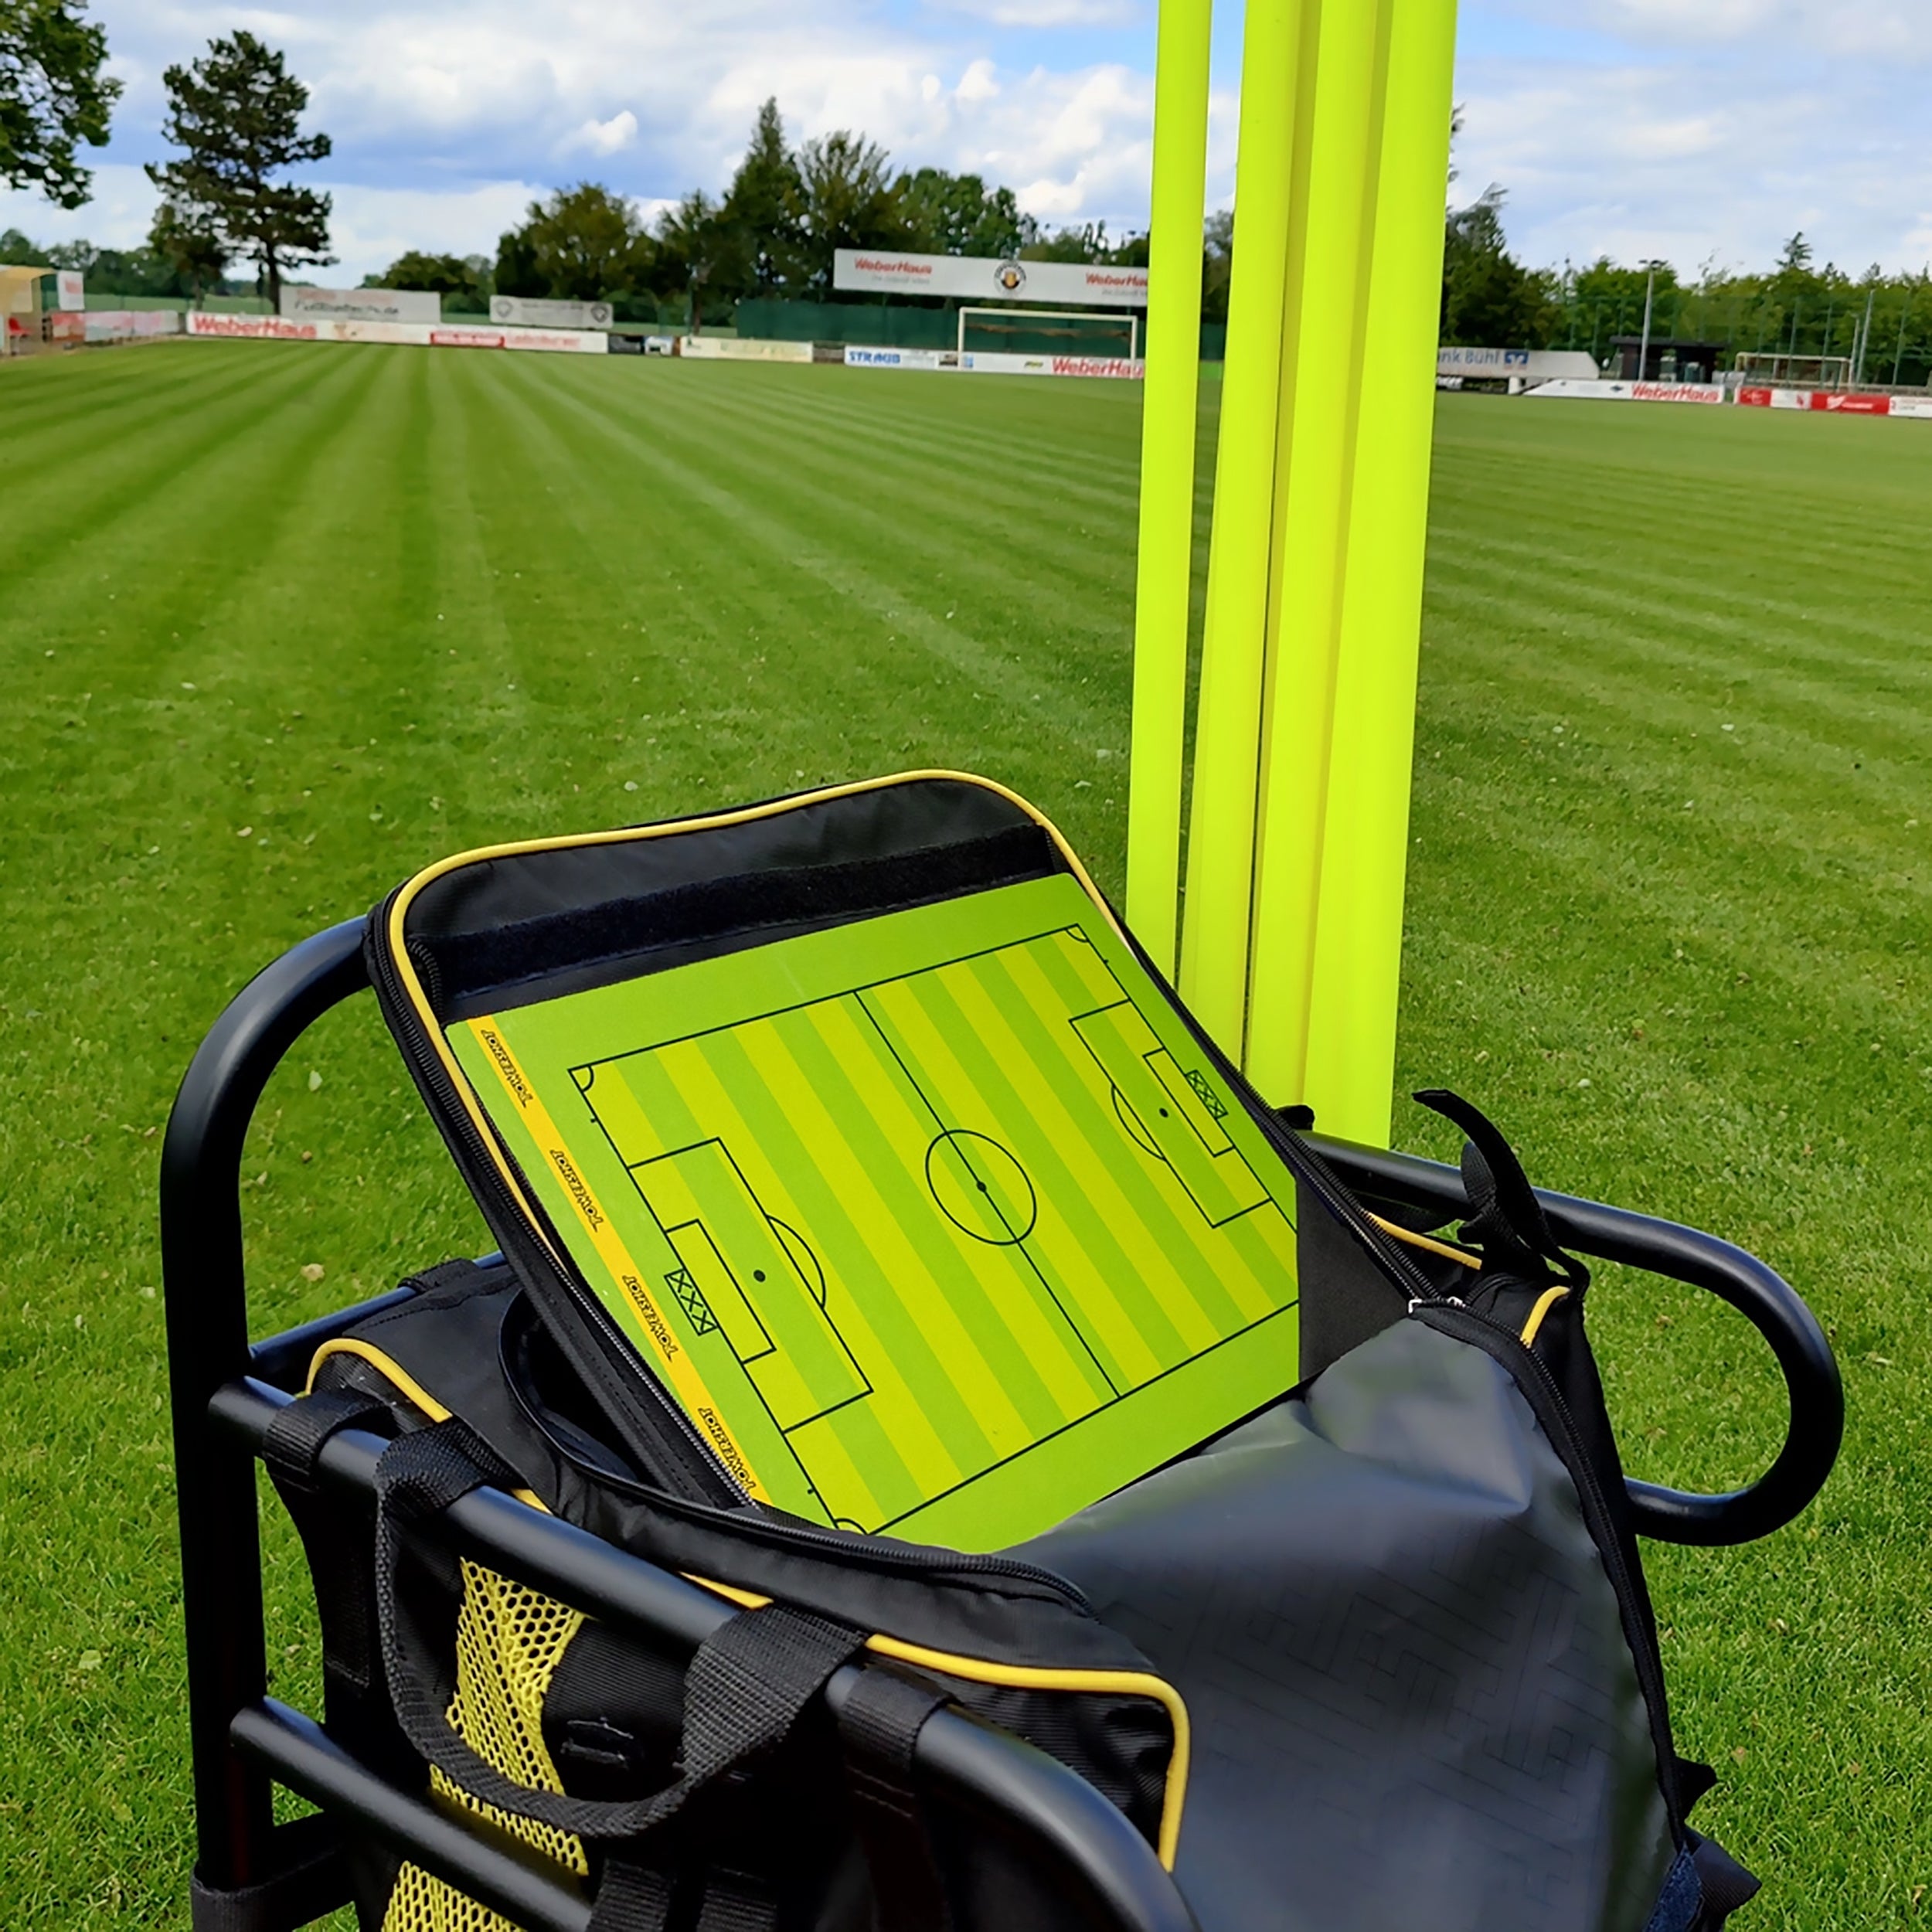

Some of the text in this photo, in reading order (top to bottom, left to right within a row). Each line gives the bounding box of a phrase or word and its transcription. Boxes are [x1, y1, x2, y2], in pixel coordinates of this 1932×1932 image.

[854, 257, 932, 274] WeberHaus
[194, 315, 317, 338] WeberHaus
[1052, 355, 1145, 379] WeberHau
[1440, 349, 1460, 363] nk
[1632, 383, 1719, 401] WeberHaus
[481, 1029, 533, 1108] POWERSHOT
[549, 1149, 604, 1233] POWERSHOT
[622, 1275, 679, 1363] POWERSHOT
[698, 1407, 757, 1491] POWERSHOT
